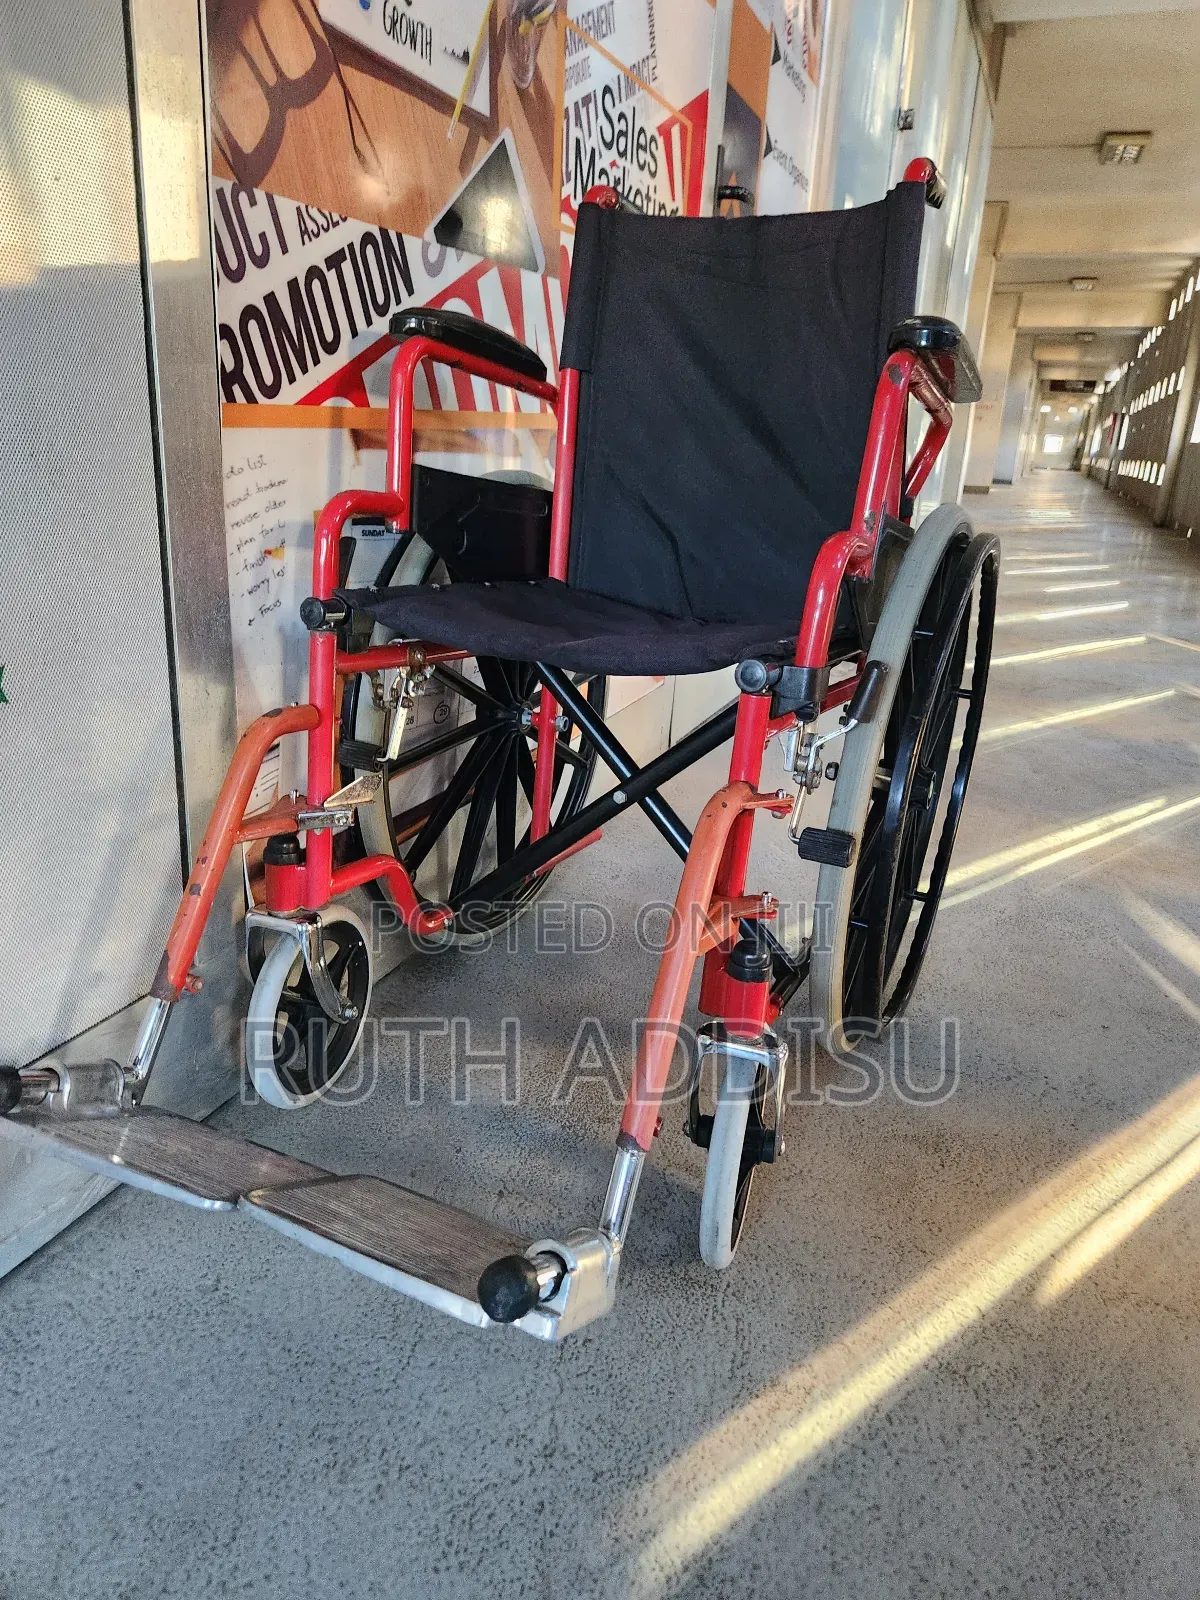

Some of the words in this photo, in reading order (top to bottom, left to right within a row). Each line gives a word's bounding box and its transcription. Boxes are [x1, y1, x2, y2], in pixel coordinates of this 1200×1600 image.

[383, 0, 433, 67] GROWTH
[600, 84, 659, 179] Sales
[361, 529, 385, 538] SUNDAY
